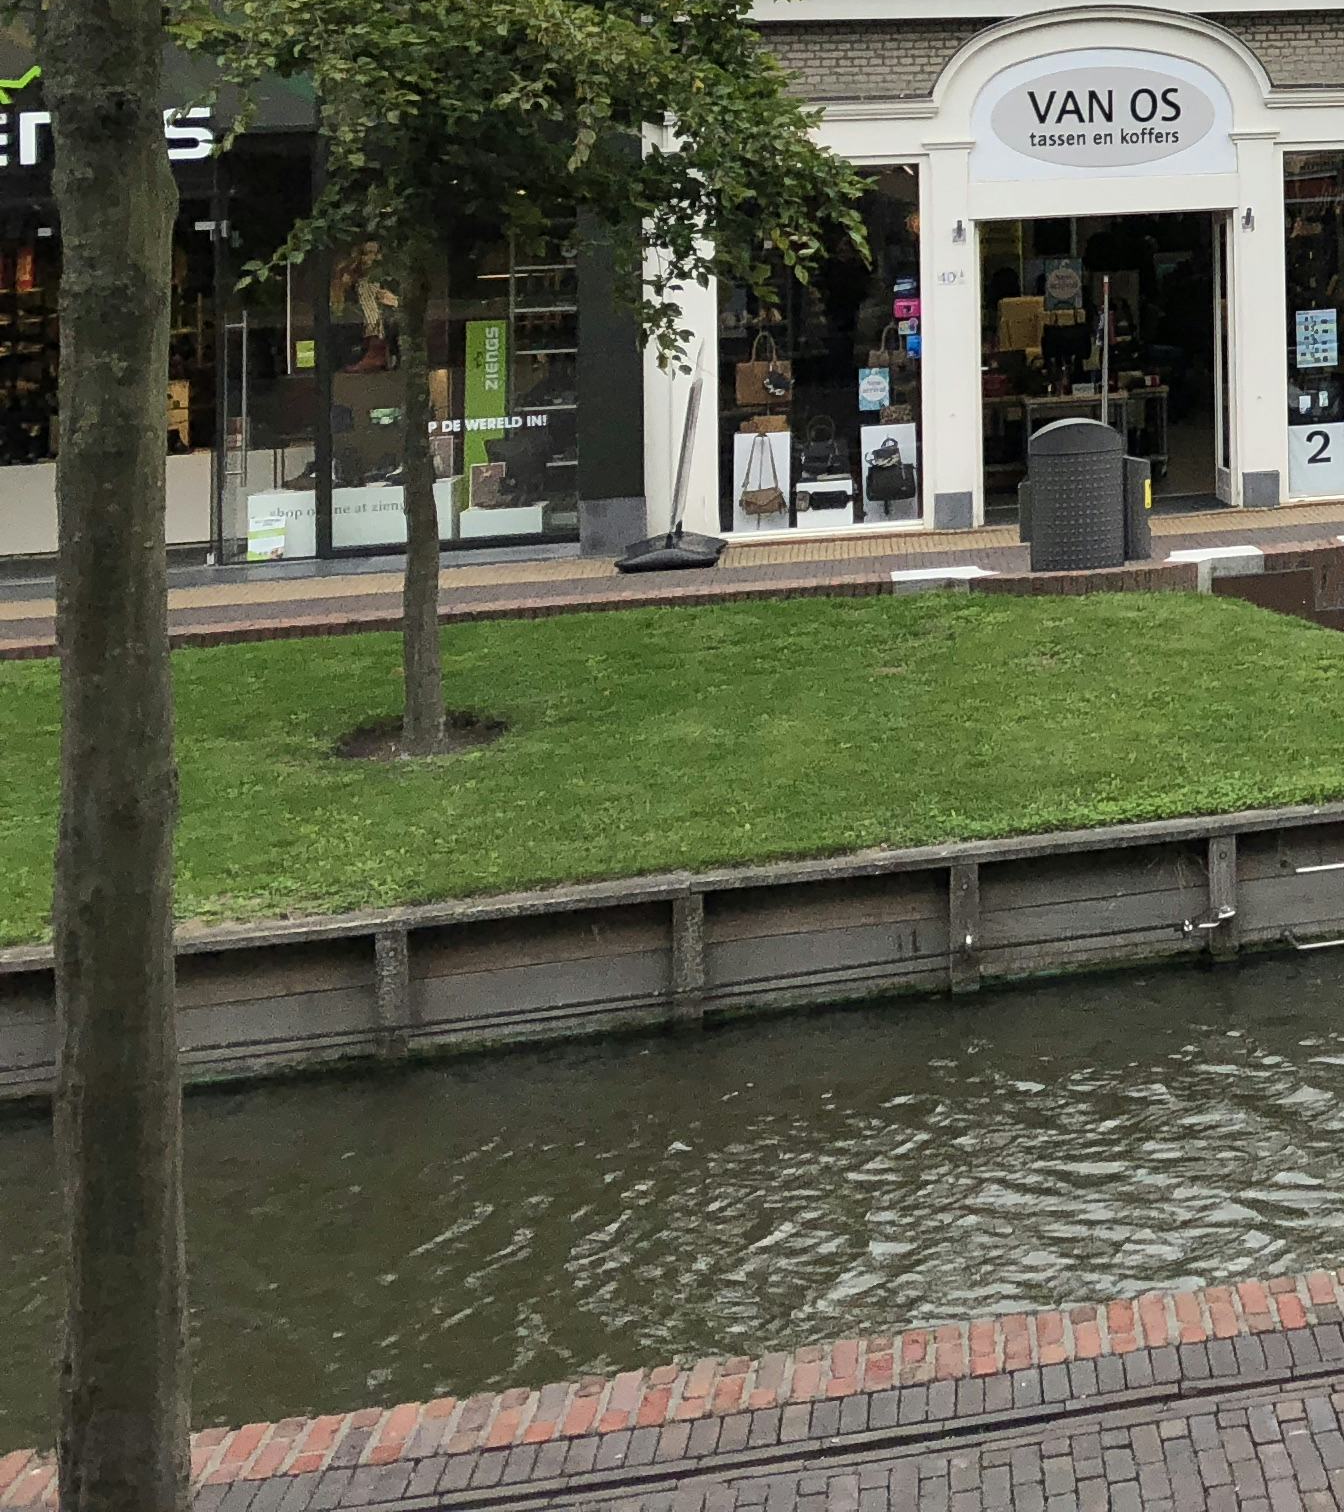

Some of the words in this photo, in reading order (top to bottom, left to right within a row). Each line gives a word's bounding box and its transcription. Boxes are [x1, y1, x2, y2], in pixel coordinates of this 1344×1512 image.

[1027, 89, 1114, 124] VAN
[1130, 87, 1182, 123] OS
[1029, 131, 1086, 147] tassen
[1093, 132, 1113, 145] en
[1120, 127, 1180, 145] koffers
[427, 421, 438, 434] P
[441, 419, 461, 433] DE
[465, 415, 523, 432] WERELD
[526, 414, 548, 428] IN!
[1305, 429, 1332, 465] 2
